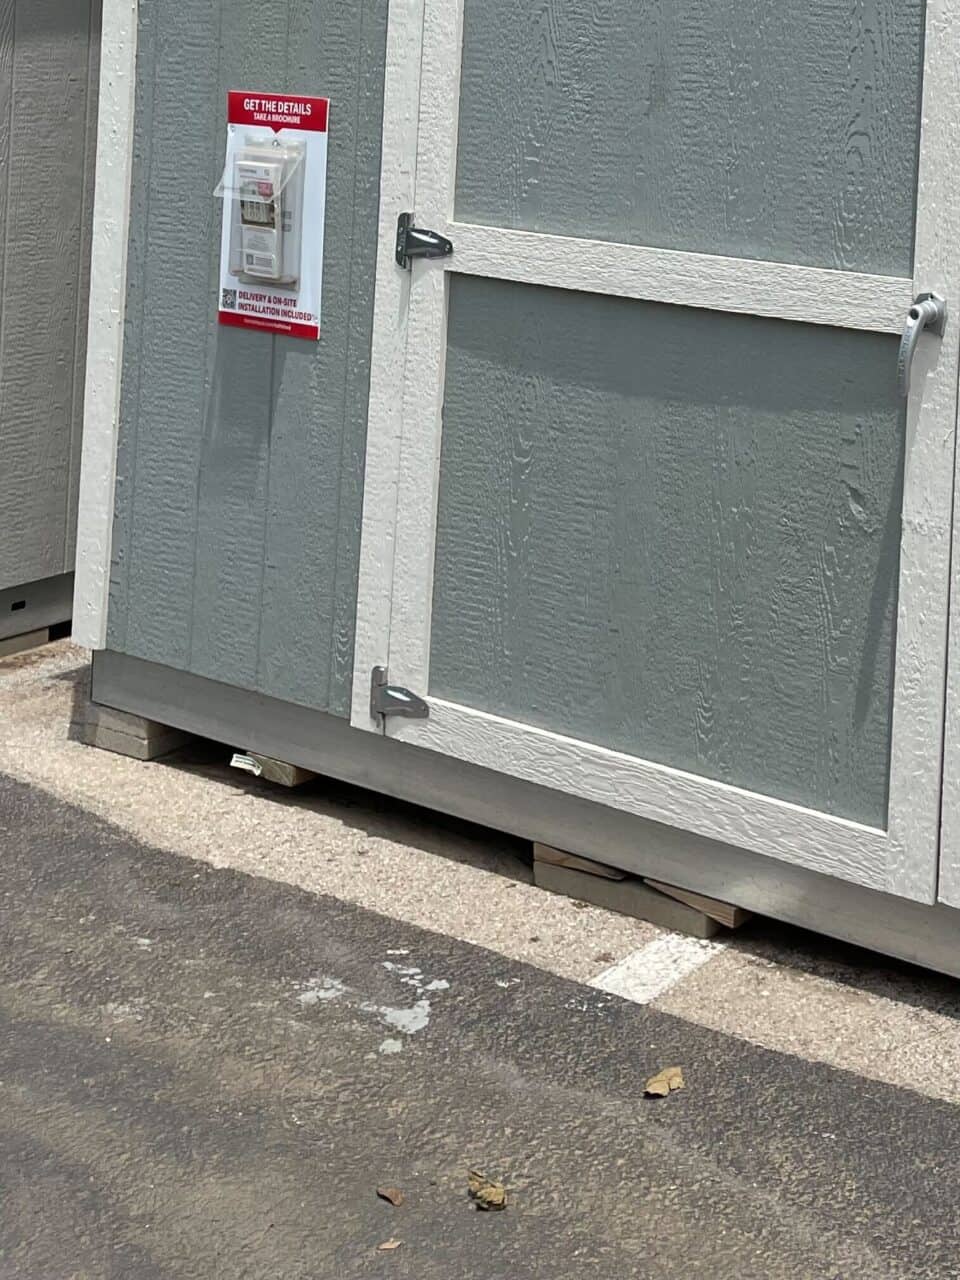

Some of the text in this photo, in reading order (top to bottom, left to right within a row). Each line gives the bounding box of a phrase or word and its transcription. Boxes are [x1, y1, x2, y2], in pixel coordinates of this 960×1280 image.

[244, 98, 311, 116] GET THE DETAILS
[254, 112, 300, 124] TAKE A BROCHURE
[239, 291, 266, 303] DELIVERY
[273, 296, 297, 307] ON-SITE
[238, 303, 280, 316] INSTALLATION
